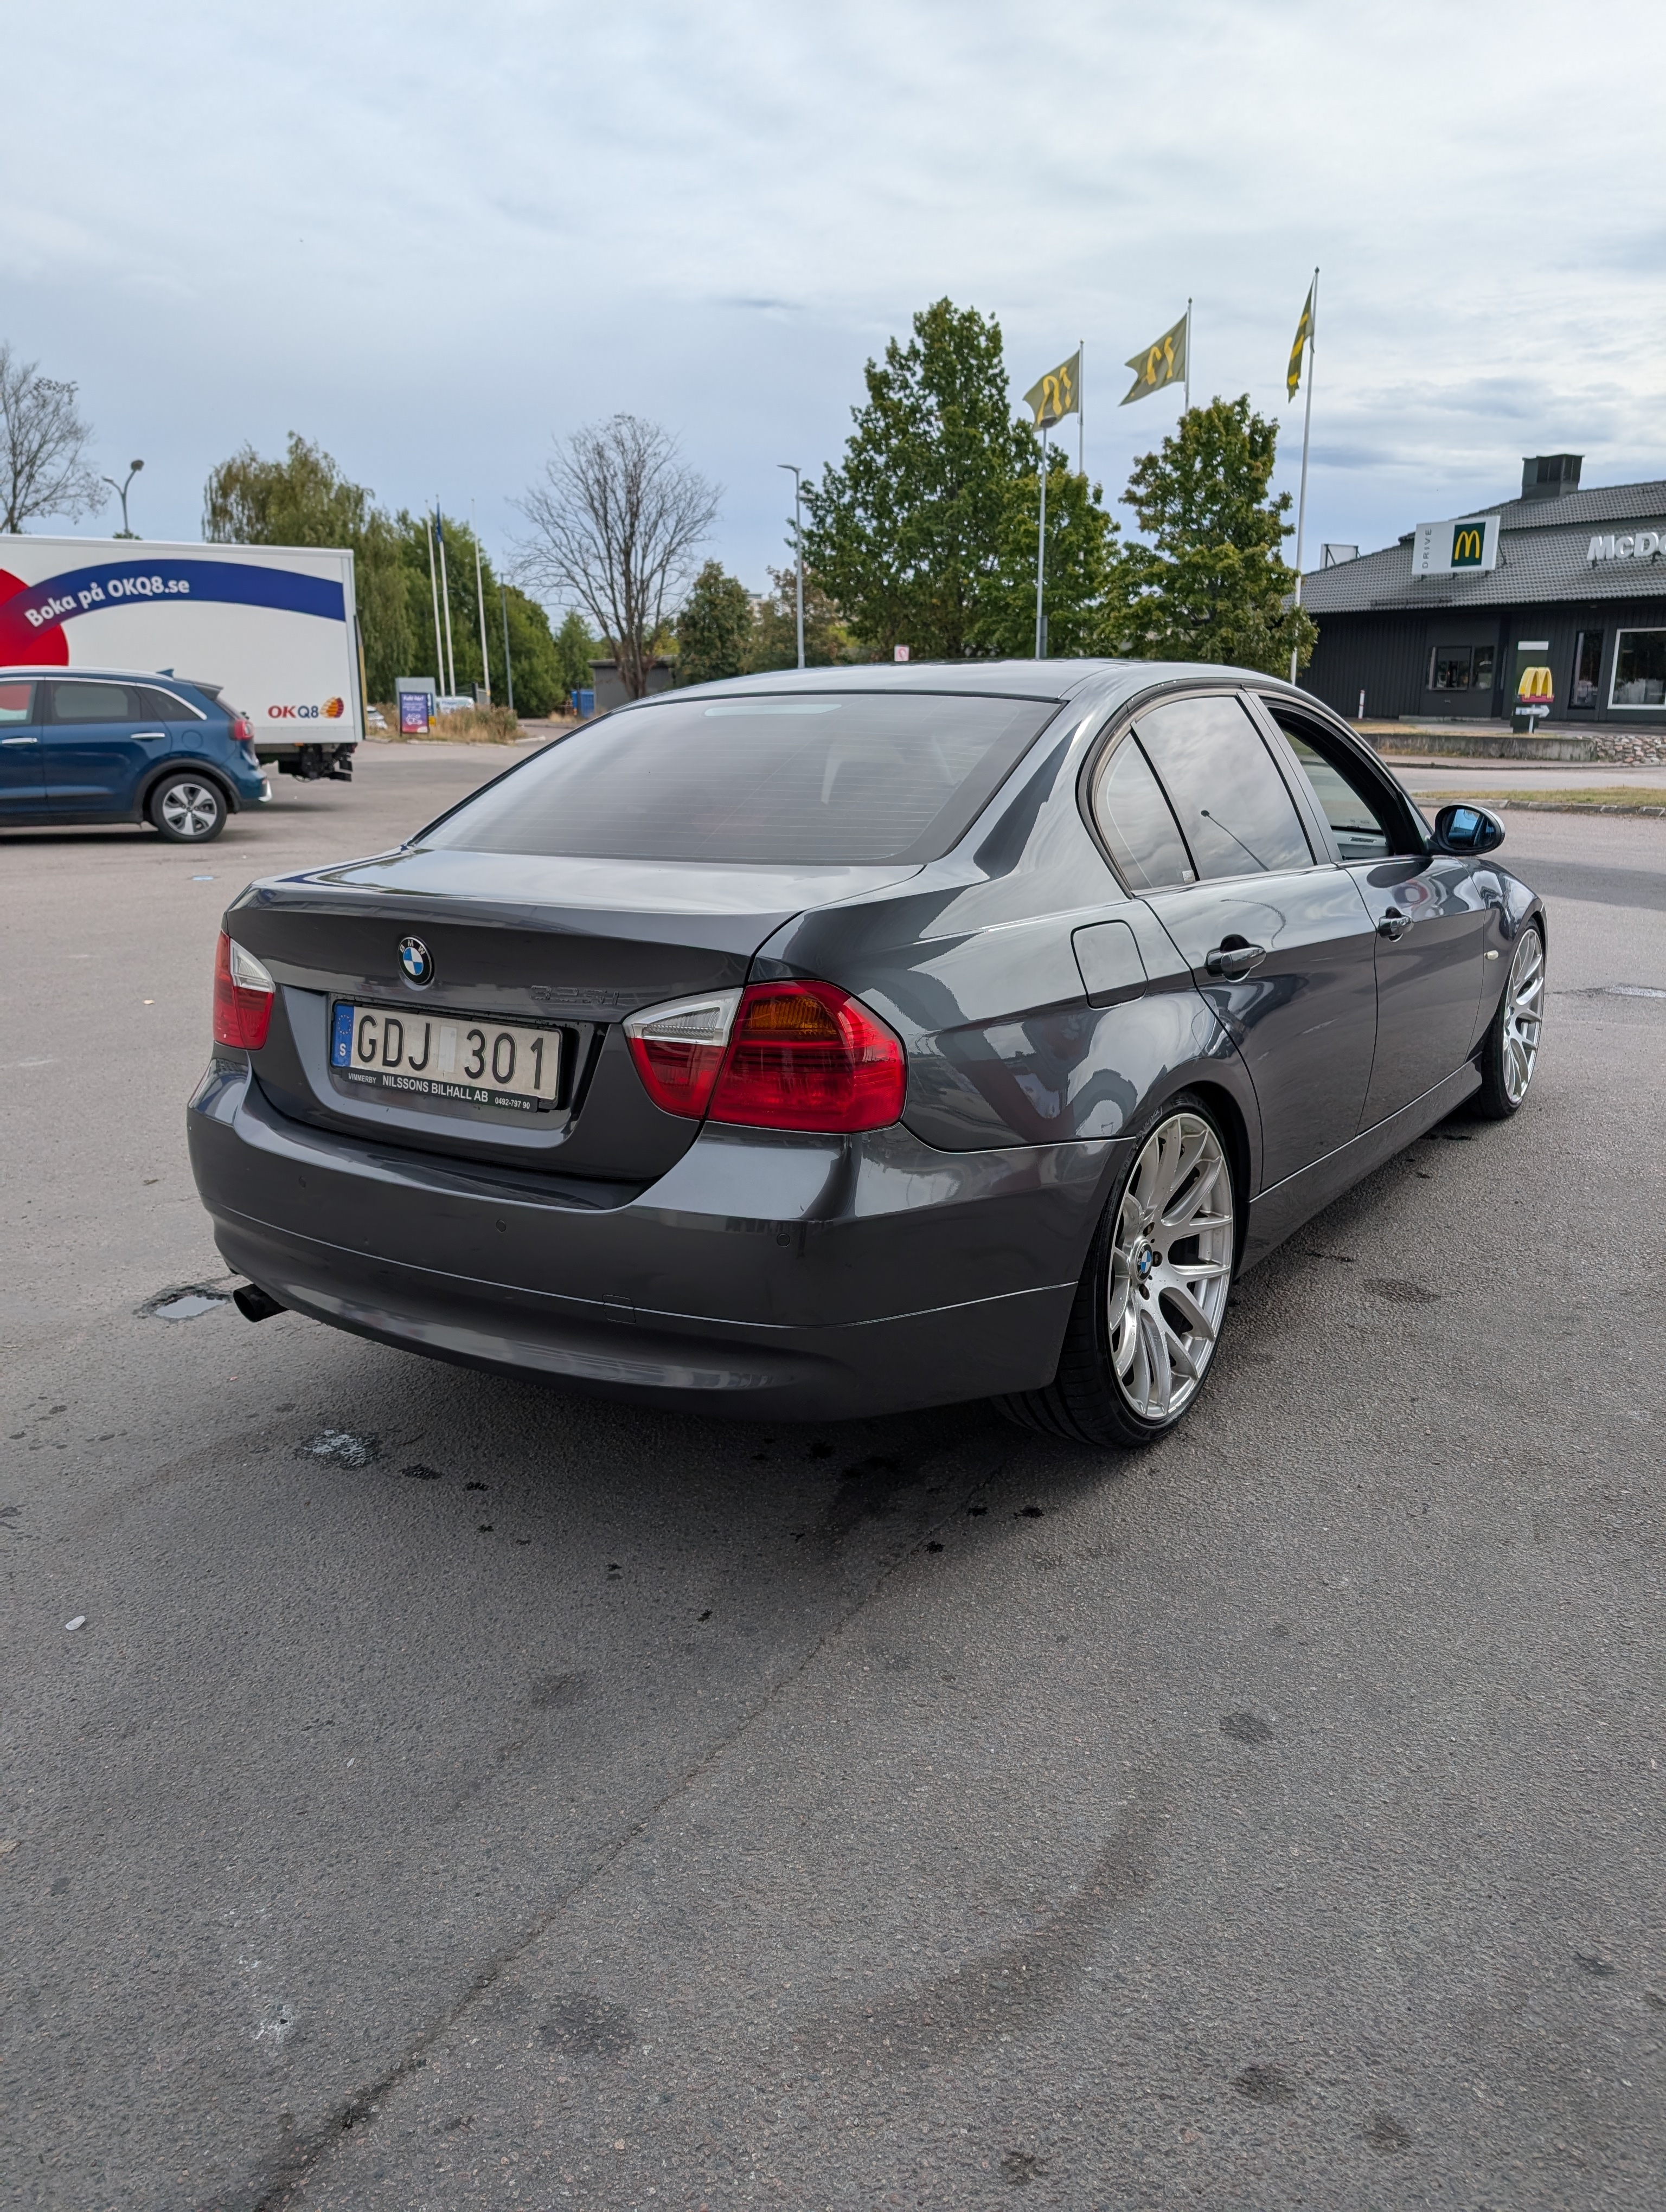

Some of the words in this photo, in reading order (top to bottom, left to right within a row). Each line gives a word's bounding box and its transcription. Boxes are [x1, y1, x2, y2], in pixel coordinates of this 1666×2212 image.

[1422, 529, 1432, 569] DRIVE
[23, 595, 77, 627] Boka
[78, 581, 106, 609] på
[107, 575, 190, 597] OKQ8.se
[399, 939, 426, 955] BMW
[339, 1043, 347, 1057] S
[357, 1014, 432, 1071] GDJ
[464, 1028, 544, 1090] 301
[348, 1072, 376, 1084] VIMMERBY
[382, 1075, 429, 1092] NILSSONS
[431, 1083, 472, 1100] BILHALL
[473, 1090, 489, 1102] AB
[495, 1097, 522, 1108] 0492-797
[522, 1101, 530, 1109] 90
